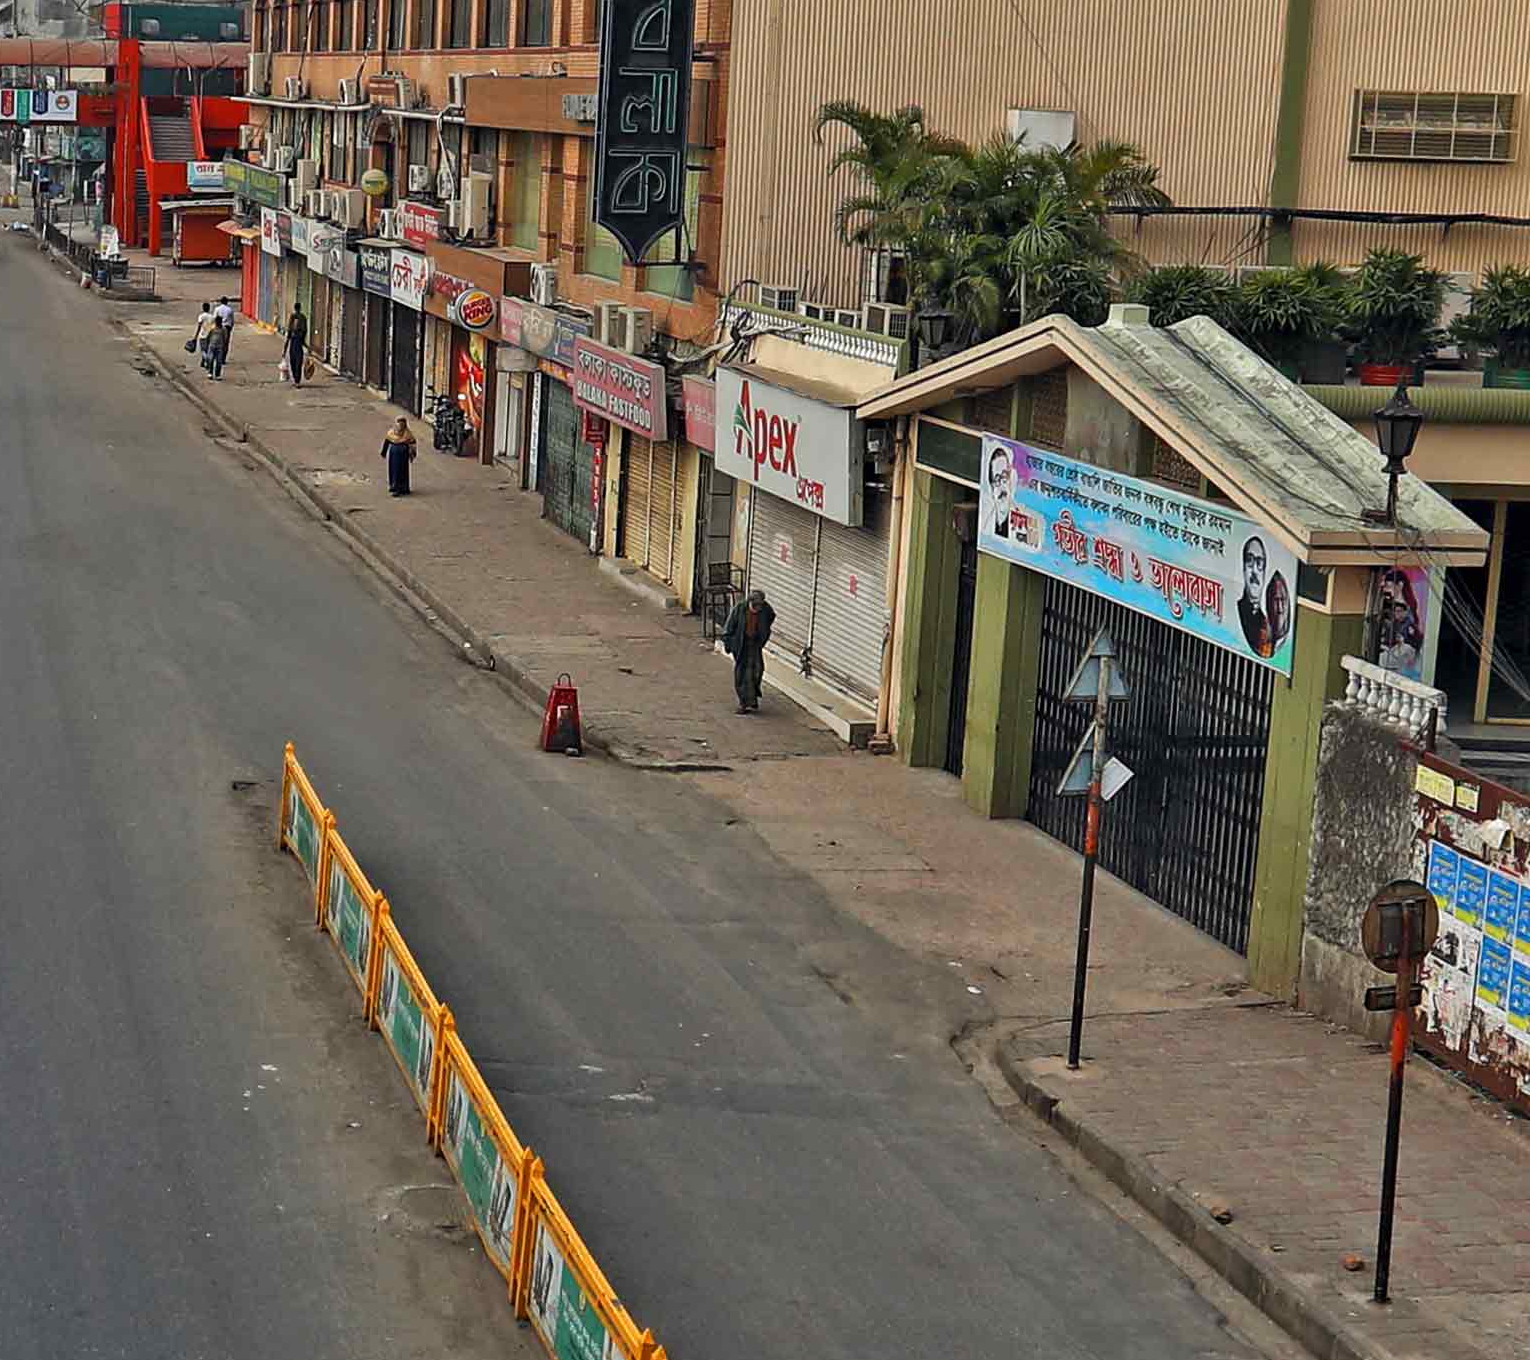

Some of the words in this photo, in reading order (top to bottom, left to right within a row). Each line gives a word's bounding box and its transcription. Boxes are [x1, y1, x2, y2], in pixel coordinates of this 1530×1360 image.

[463, 303, 494, 321] KING
[732, 380, 799, 482] Apex
[1147, 556, 1225, 623] ভালোবাসা
